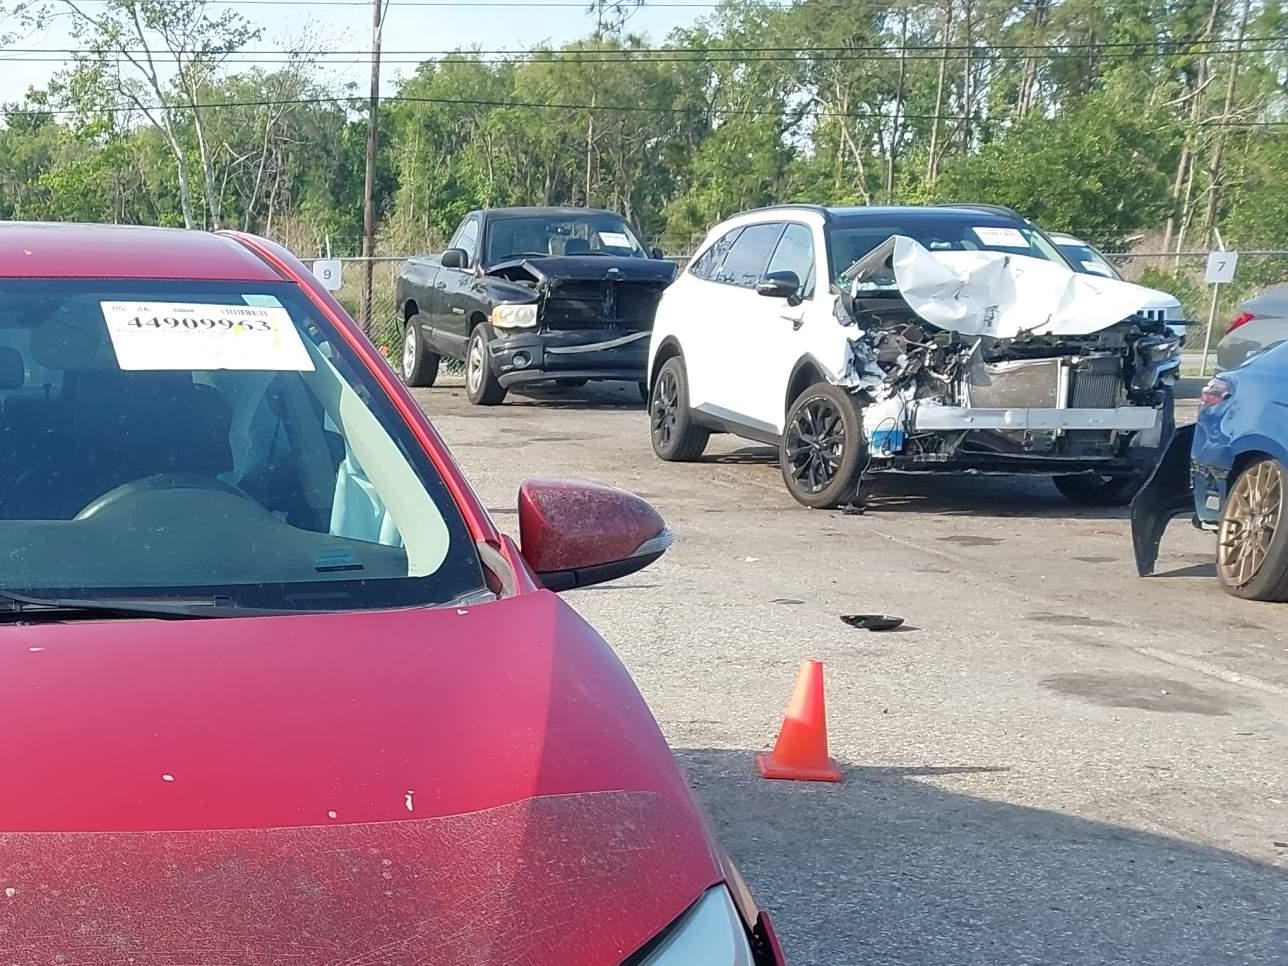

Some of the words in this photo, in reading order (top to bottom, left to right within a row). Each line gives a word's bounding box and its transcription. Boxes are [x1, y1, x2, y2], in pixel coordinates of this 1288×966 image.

[1217, 261, 1226, 272] 7
[323, 268, 332, 280] 9
[127, 316, 272, 332] 44909963
